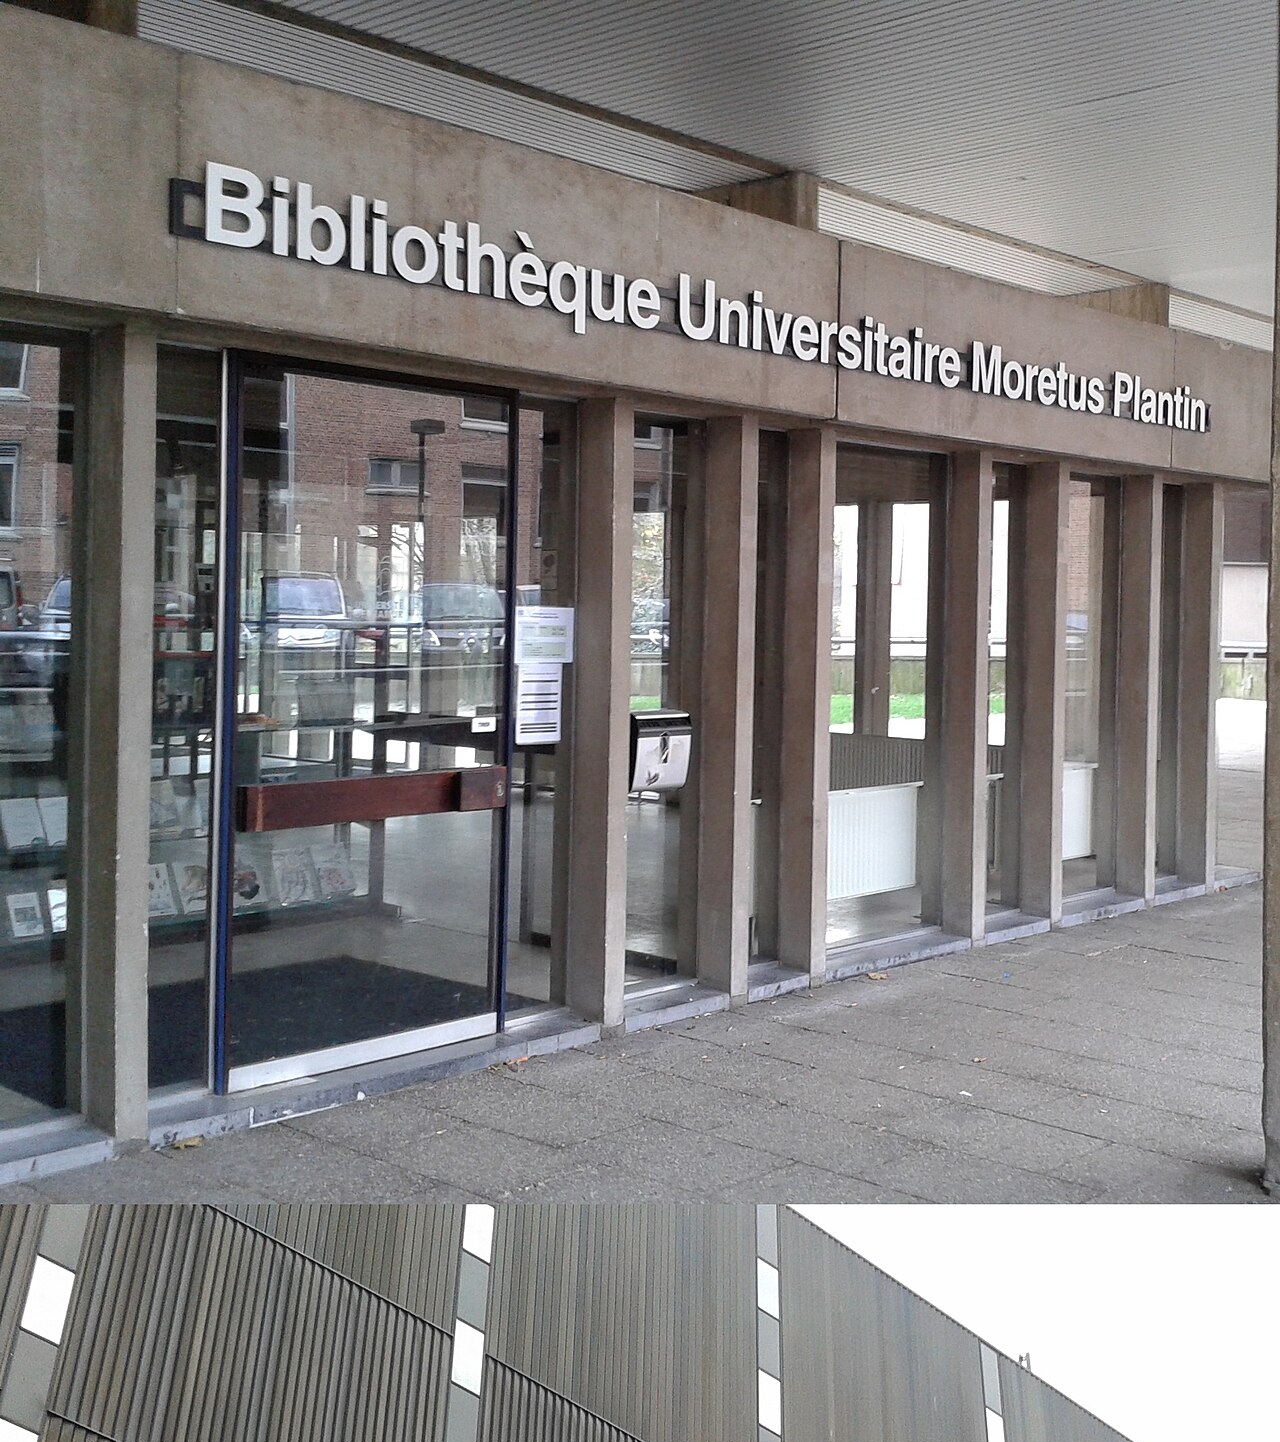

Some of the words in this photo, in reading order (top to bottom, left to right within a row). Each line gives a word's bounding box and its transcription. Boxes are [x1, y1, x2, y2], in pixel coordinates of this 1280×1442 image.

[205, 160, 662, 335] Bibliothèque
[678, 272, 961, 390] Universitaire
[971, 340, 1105, 415] Moretus
[1113, 371, 1208, 433] Plantin
